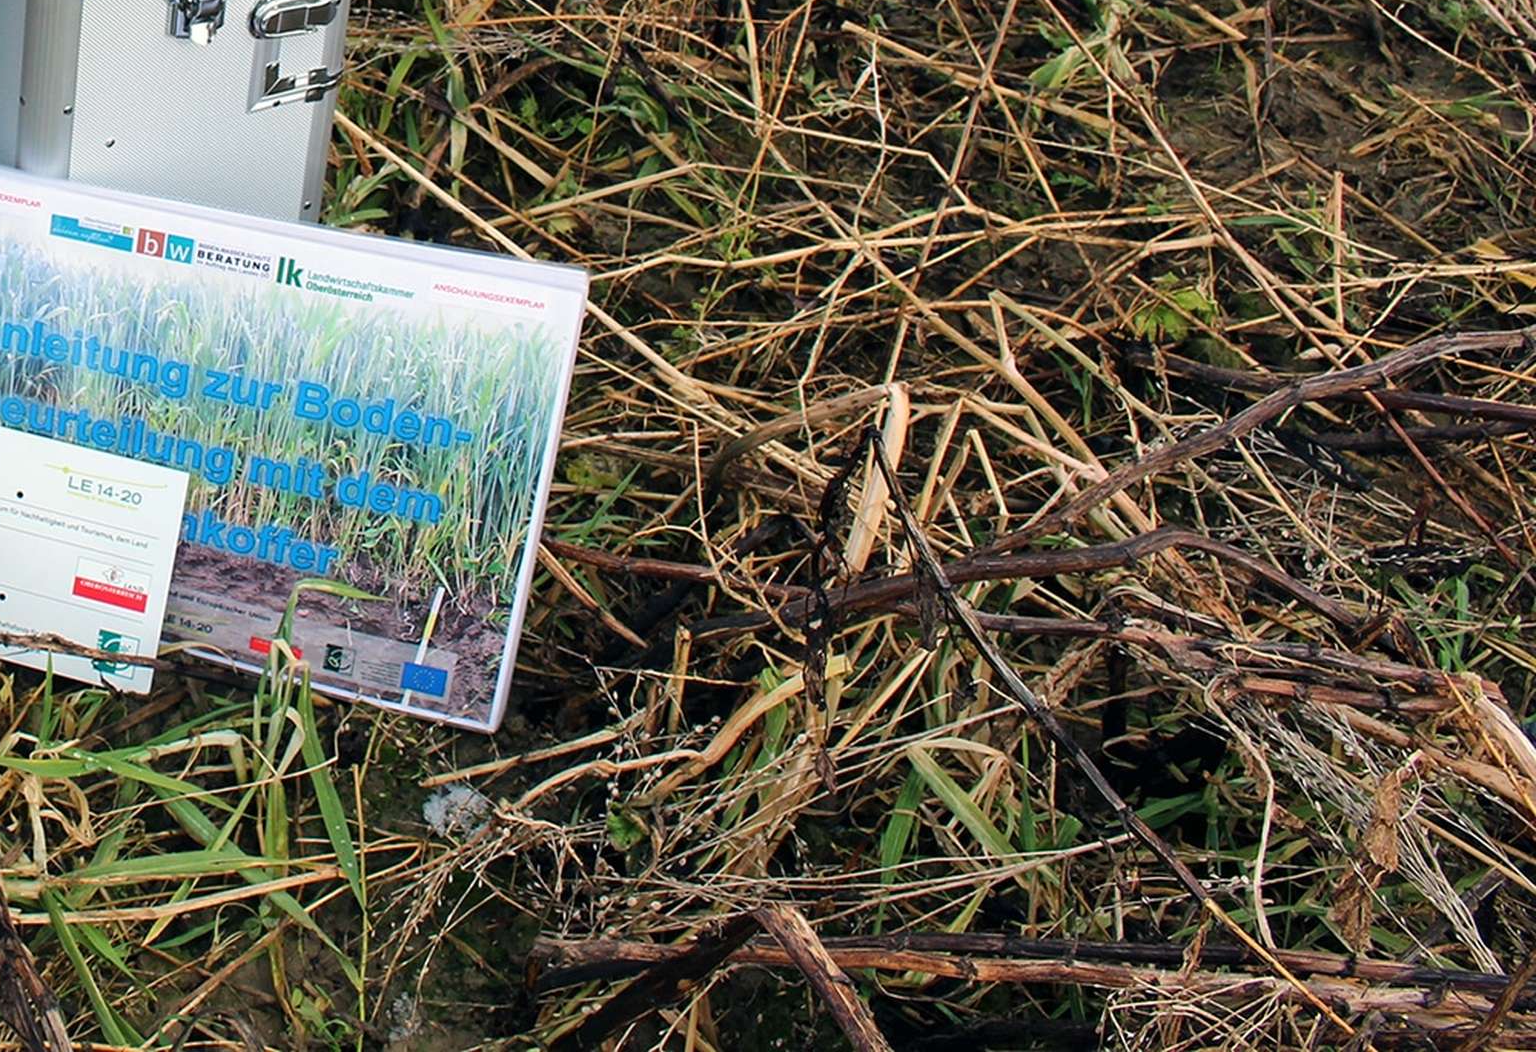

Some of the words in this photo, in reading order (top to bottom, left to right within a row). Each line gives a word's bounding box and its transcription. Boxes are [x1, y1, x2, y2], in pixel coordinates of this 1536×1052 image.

[197, 249, 271, 272] BERATUNG
[305, 280, 373, 303] Oberösterreich
[307, 269, 415, 299] Landwirtschaftskammer
[433, 283, 545, 310] ANSCHAUUNGSEXEMPLAR
[201, 369, 283, 411] zur
[293, 379, 473, 448] Boden-
[67, 475, 93, 494] LE
[97, 483, 143, 506] 14-20
[248, 454, 326, 500] mit
[335, 470, 443, 525] dem
[179, 617, 214, 634] 14-20
